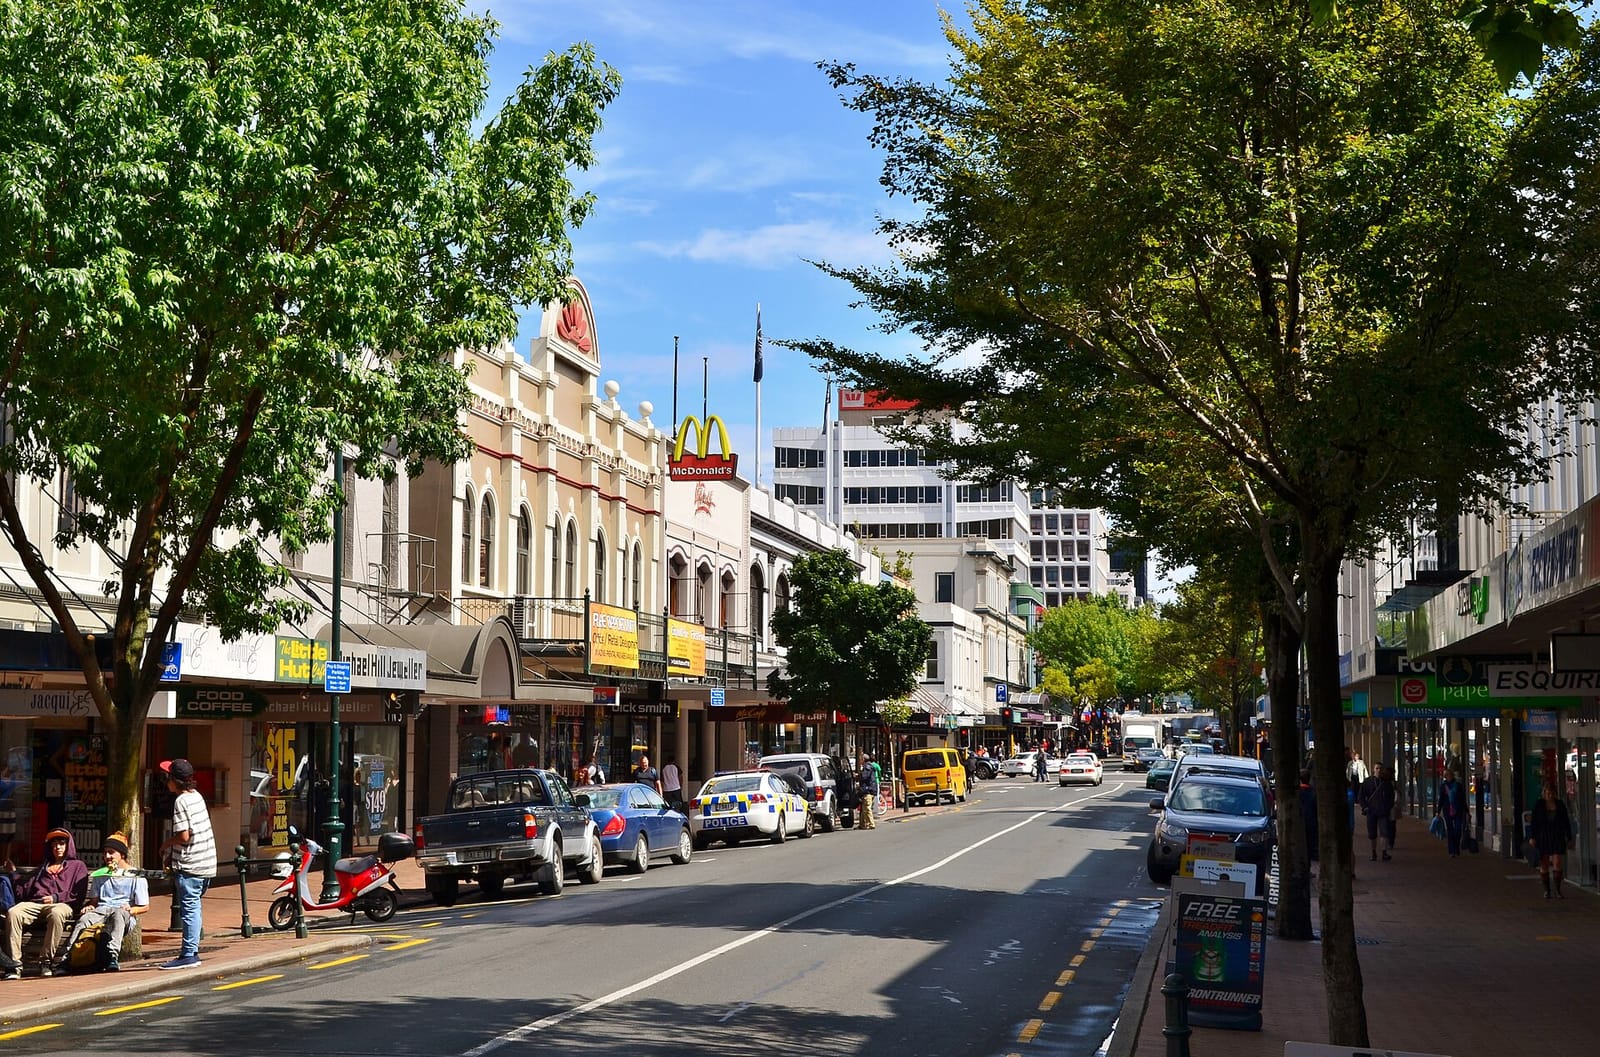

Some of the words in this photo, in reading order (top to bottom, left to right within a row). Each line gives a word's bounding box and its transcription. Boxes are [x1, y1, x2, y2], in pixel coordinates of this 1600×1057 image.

[671, 467, 733, 475] McDonald's
[279, 640, 291, 655] The
[279, 658, 311, 678] Hut
[371, 653, 386, 677] Hill
[387, 655, 423, 680] Jeweller
[196, 690, 244, 700] FOOD
[997, 685, 1005, 695] P
[187, 702, 253, 712] COFFEE
[265, 701, 299, 713] ichael
[302, 701, 321, 713] Hill
[638, 702, 671, 714] smith
[265, 728, 296, 791] $15
[365, 790, 386, 813] $149
[704, 816, 746, 828] POLICE
[1184, 902, 1242, 919] FREE
[1197, 929, 1243, 940] ANALYSIS
[1186, 988, 1261, 1004] RONTRUNNER
